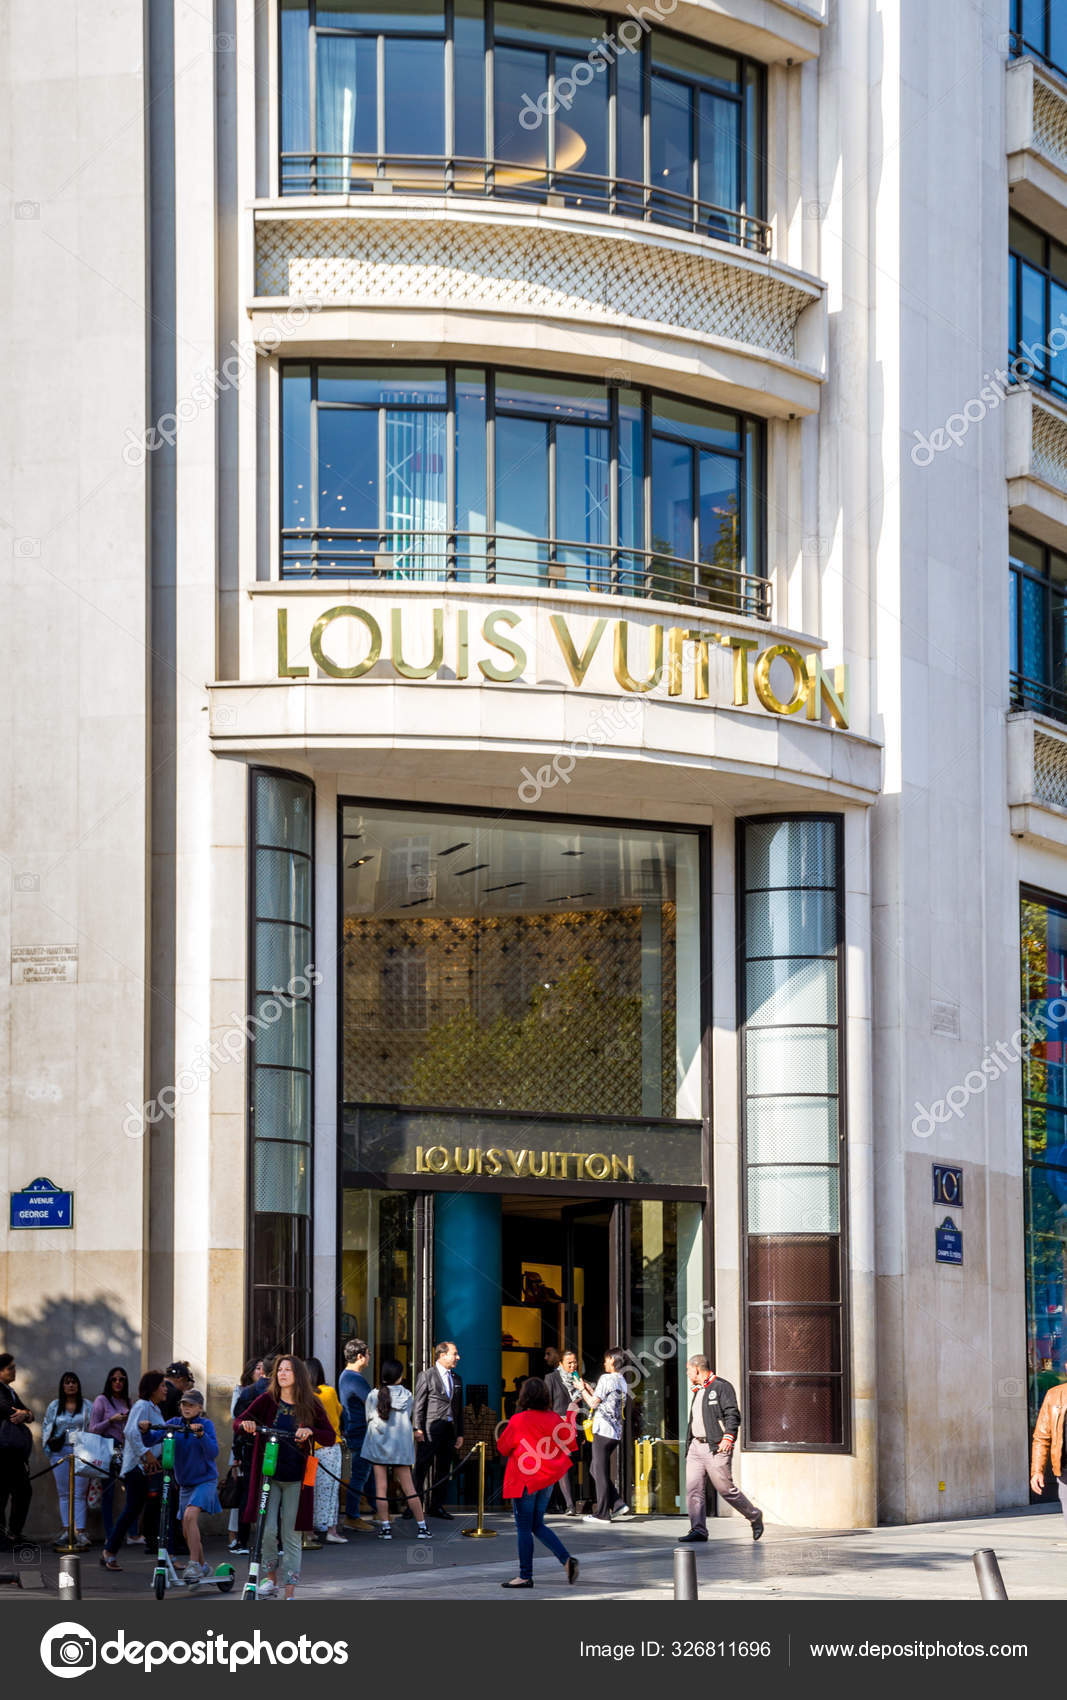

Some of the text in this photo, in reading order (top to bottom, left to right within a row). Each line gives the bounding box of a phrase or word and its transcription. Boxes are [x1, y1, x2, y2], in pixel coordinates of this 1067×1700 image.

[277, 605, 849, 730] LOUIS VUITTON
[415, 1145, 635, 1181] LOUIS VUITTON
[935, 1168, 963, 1204] 101
[19, 1210, 63, 1218] GEORGE V
